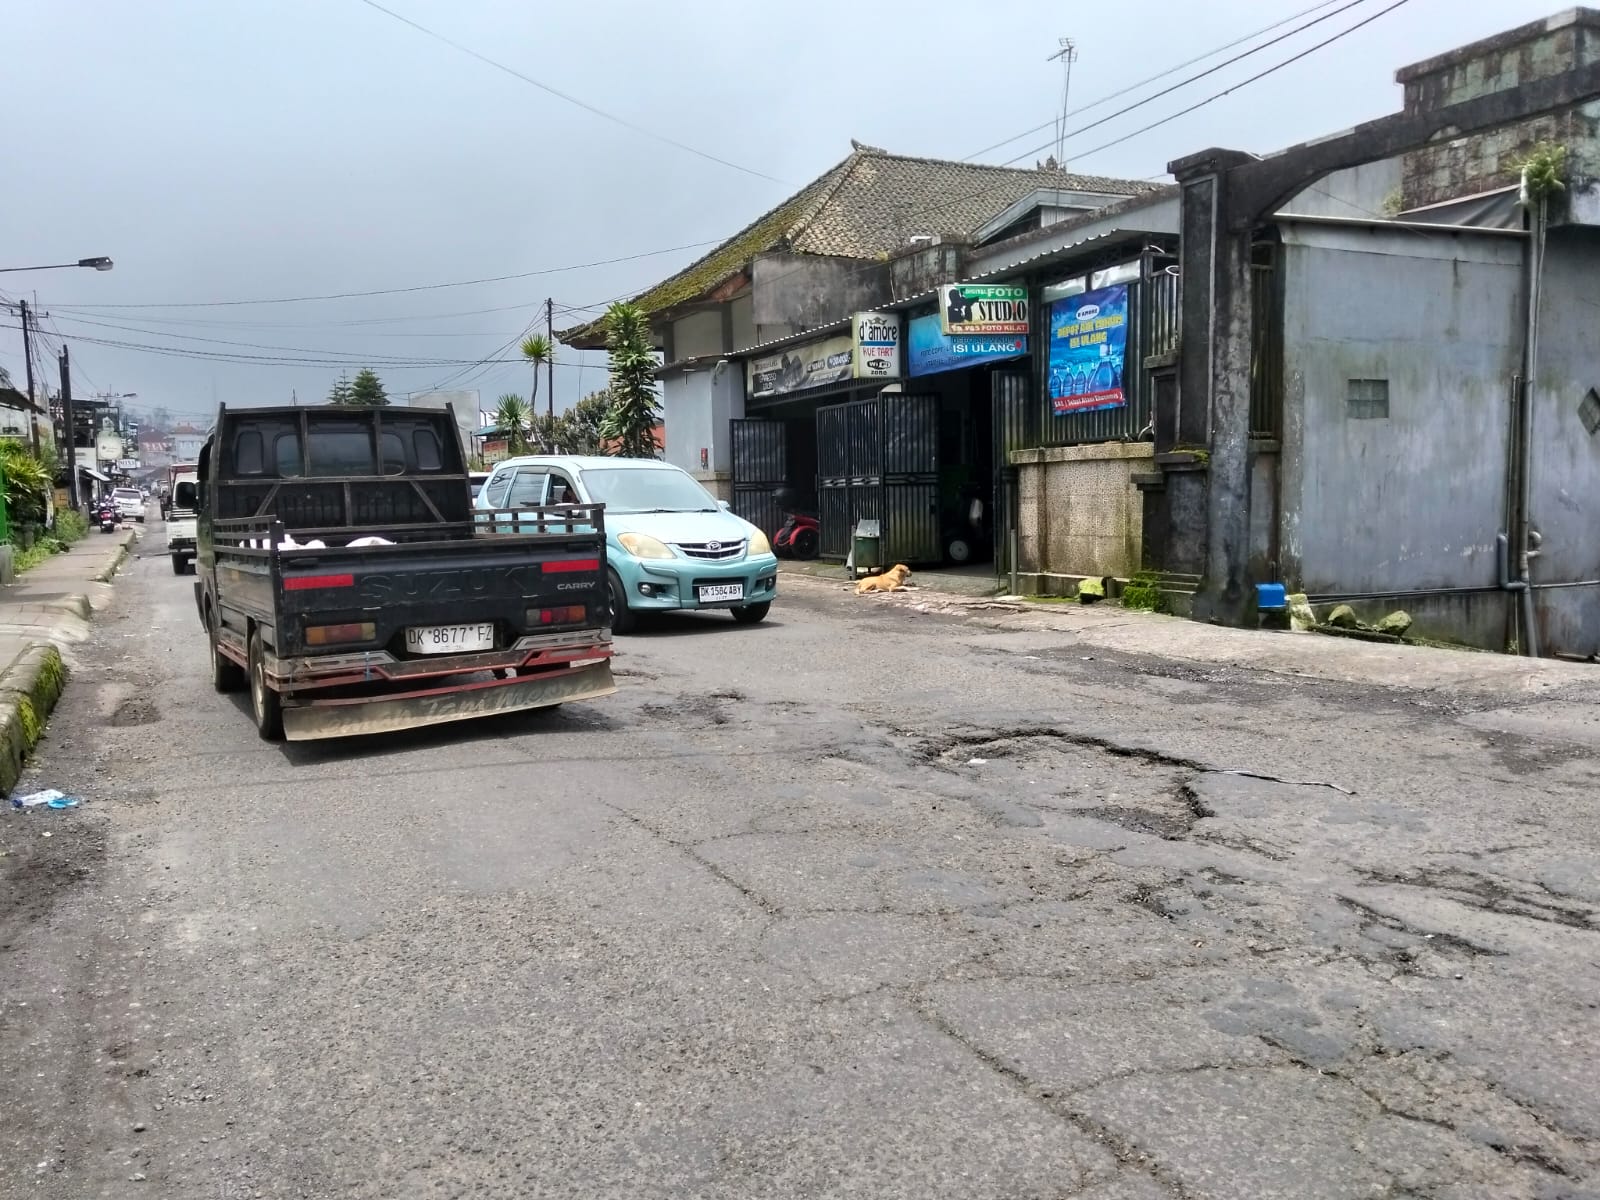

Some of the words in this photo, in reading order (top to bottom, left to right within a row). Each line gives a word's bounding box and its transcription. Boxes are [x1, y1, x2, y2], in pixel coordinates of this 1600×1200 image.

[987, 288, 1024, 297] FOTO
[979, 300, 1027, 321] STUDIO
[859, 320, 898, 341] d'amore
[952, 344, 968, 353] ISI
[971, 343, 1016, 353] ULANG
[556, 581, 596, 590] CARRY
[698, 587, 709, 597] DK
[408, 629, 424, 645] DK
[432, 627, 467, 644] 8677
[477, 625, 493, 641] FZ
